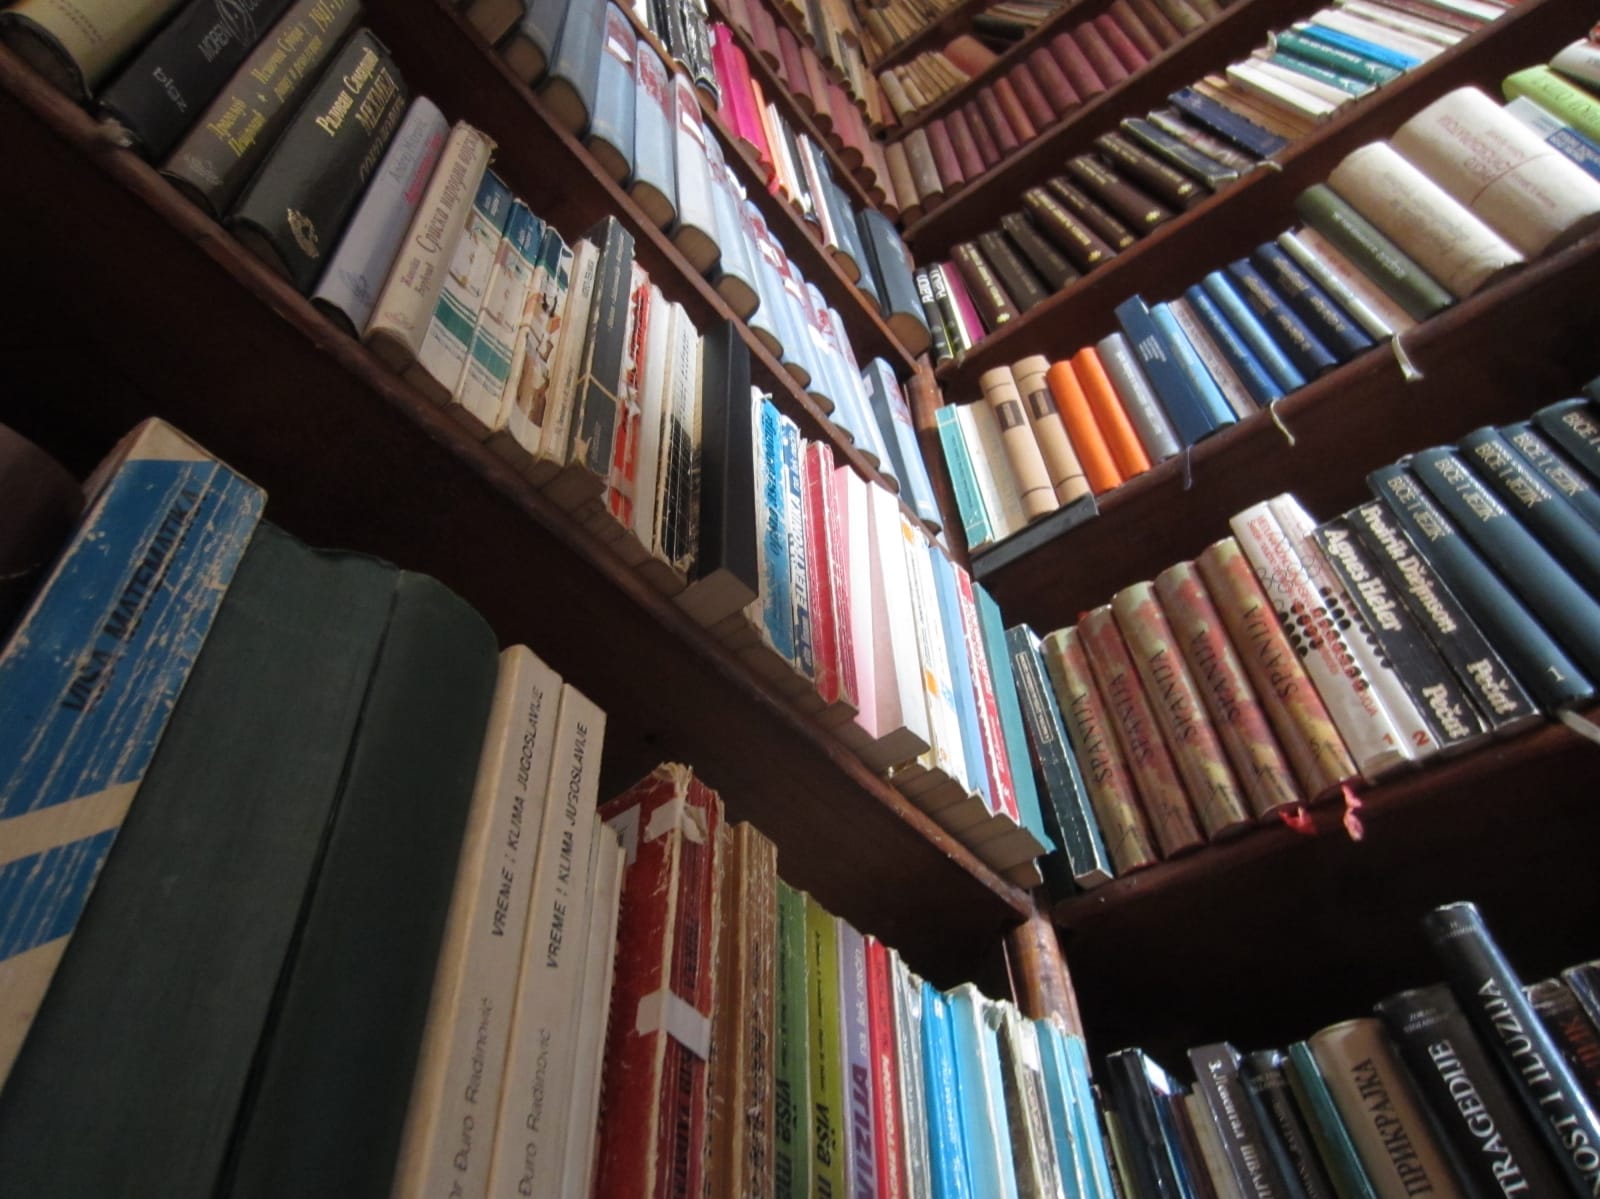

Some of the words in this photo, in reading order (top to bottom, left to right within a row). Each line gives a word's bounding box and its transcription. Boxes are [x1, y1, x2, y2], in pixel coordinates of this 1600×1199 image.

[103, 487, 208, 642] MATEMATIKA
[1323, 526, 1371, 588] Agnes
[1357, 574, 1404, 632] Heler
[1422, 682, 1470, 740] Pečat
[1467, 657, 1516, 716] Pečat
[567, 721, 589, 828] JUGOSLAVIJE
[1412, 729, 1431, 749] 2
[491, 868, 515, 938] VREME
[506, 795, 527, 850] KLIMA
[518, 685, 545, 792] JUGOSLAVIJE
[560, 826, 577, 886] KLIMA
[545, 900, 568, 970] VREME
[1478, 976, 1553, 1086] ILUZIJA
[526, 1028, 552, 1135] Radinović
[775, 1077, 797, 1144] viša
[1428, 1039, 1529, 1199] TRAGEDIJE
[1538, 1089, 1565, 1108] I
[815, 1102, 837, 1168] viša
[882, 1054, 899, 1199] GNETOSKOPI
